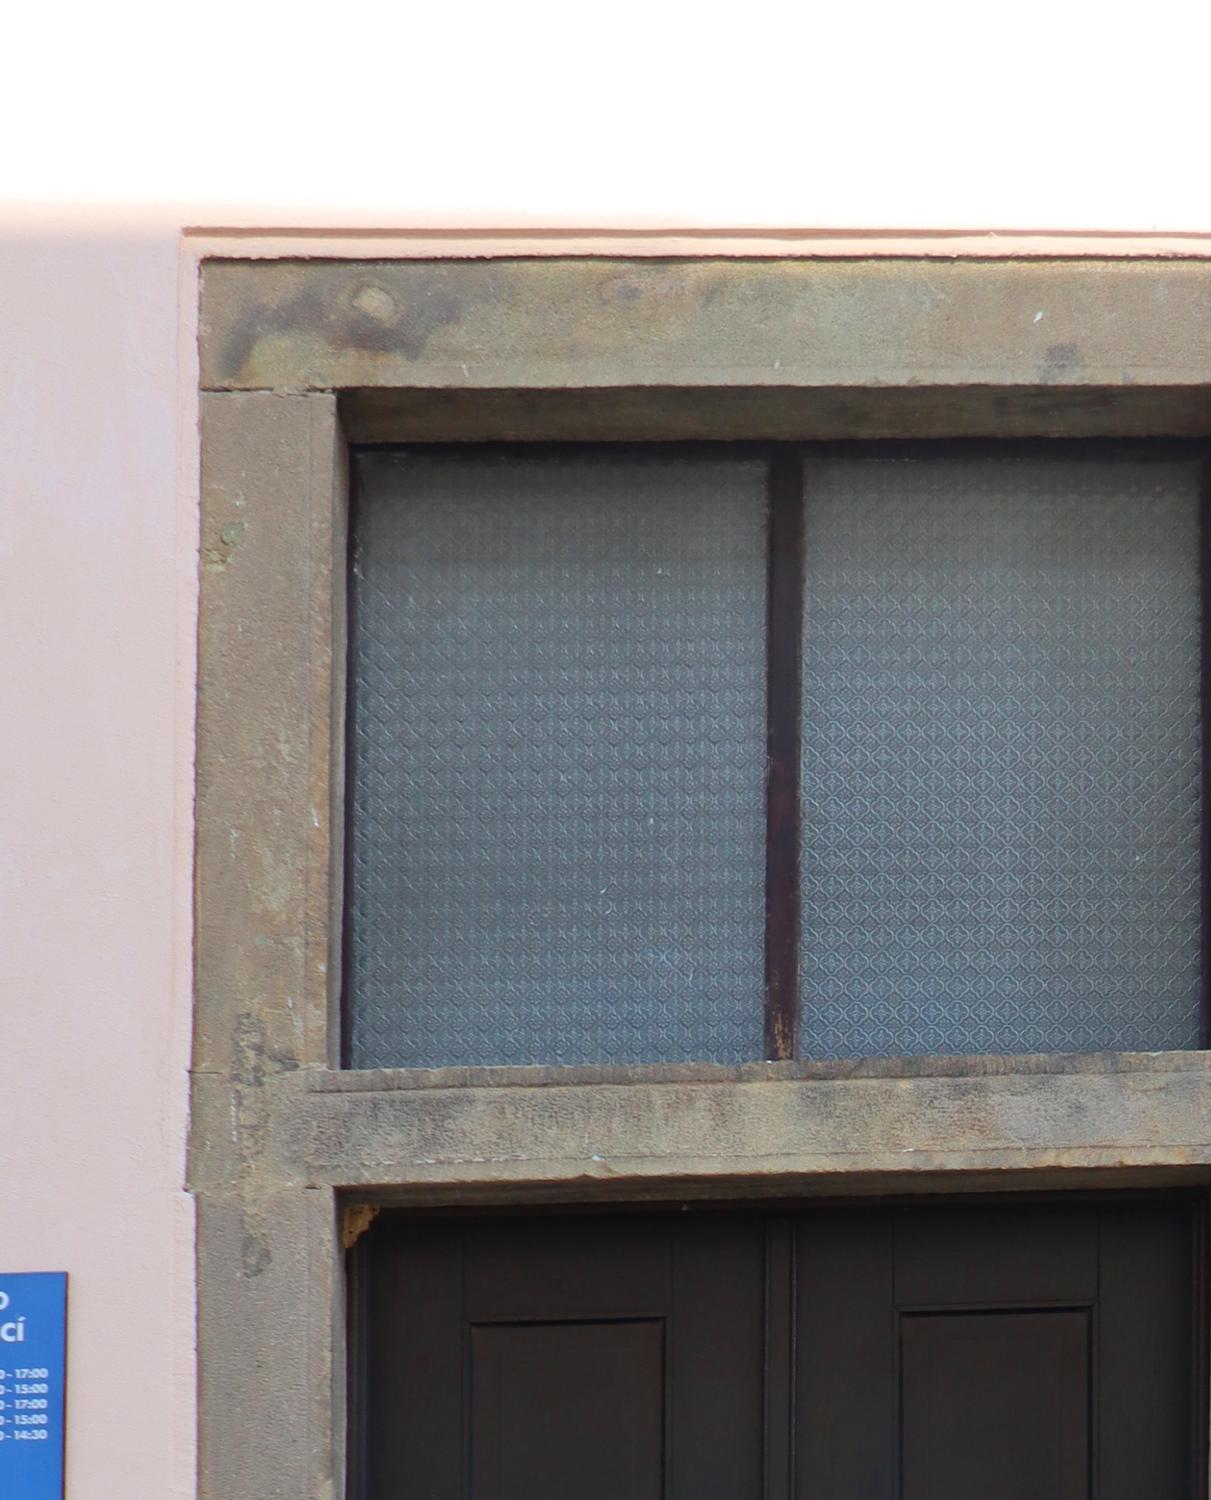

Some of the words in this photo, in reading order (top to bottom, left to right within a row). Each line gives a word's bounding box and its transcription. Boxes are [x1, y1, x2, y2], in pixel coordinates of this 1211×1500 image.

[14, 1368, 49, 1379] 17:00
[14, 1383, 49, 1394] 15:00
[14, 1398, 48, 1409] 17:00
[14, 1414, 48, 1425] 15:00
